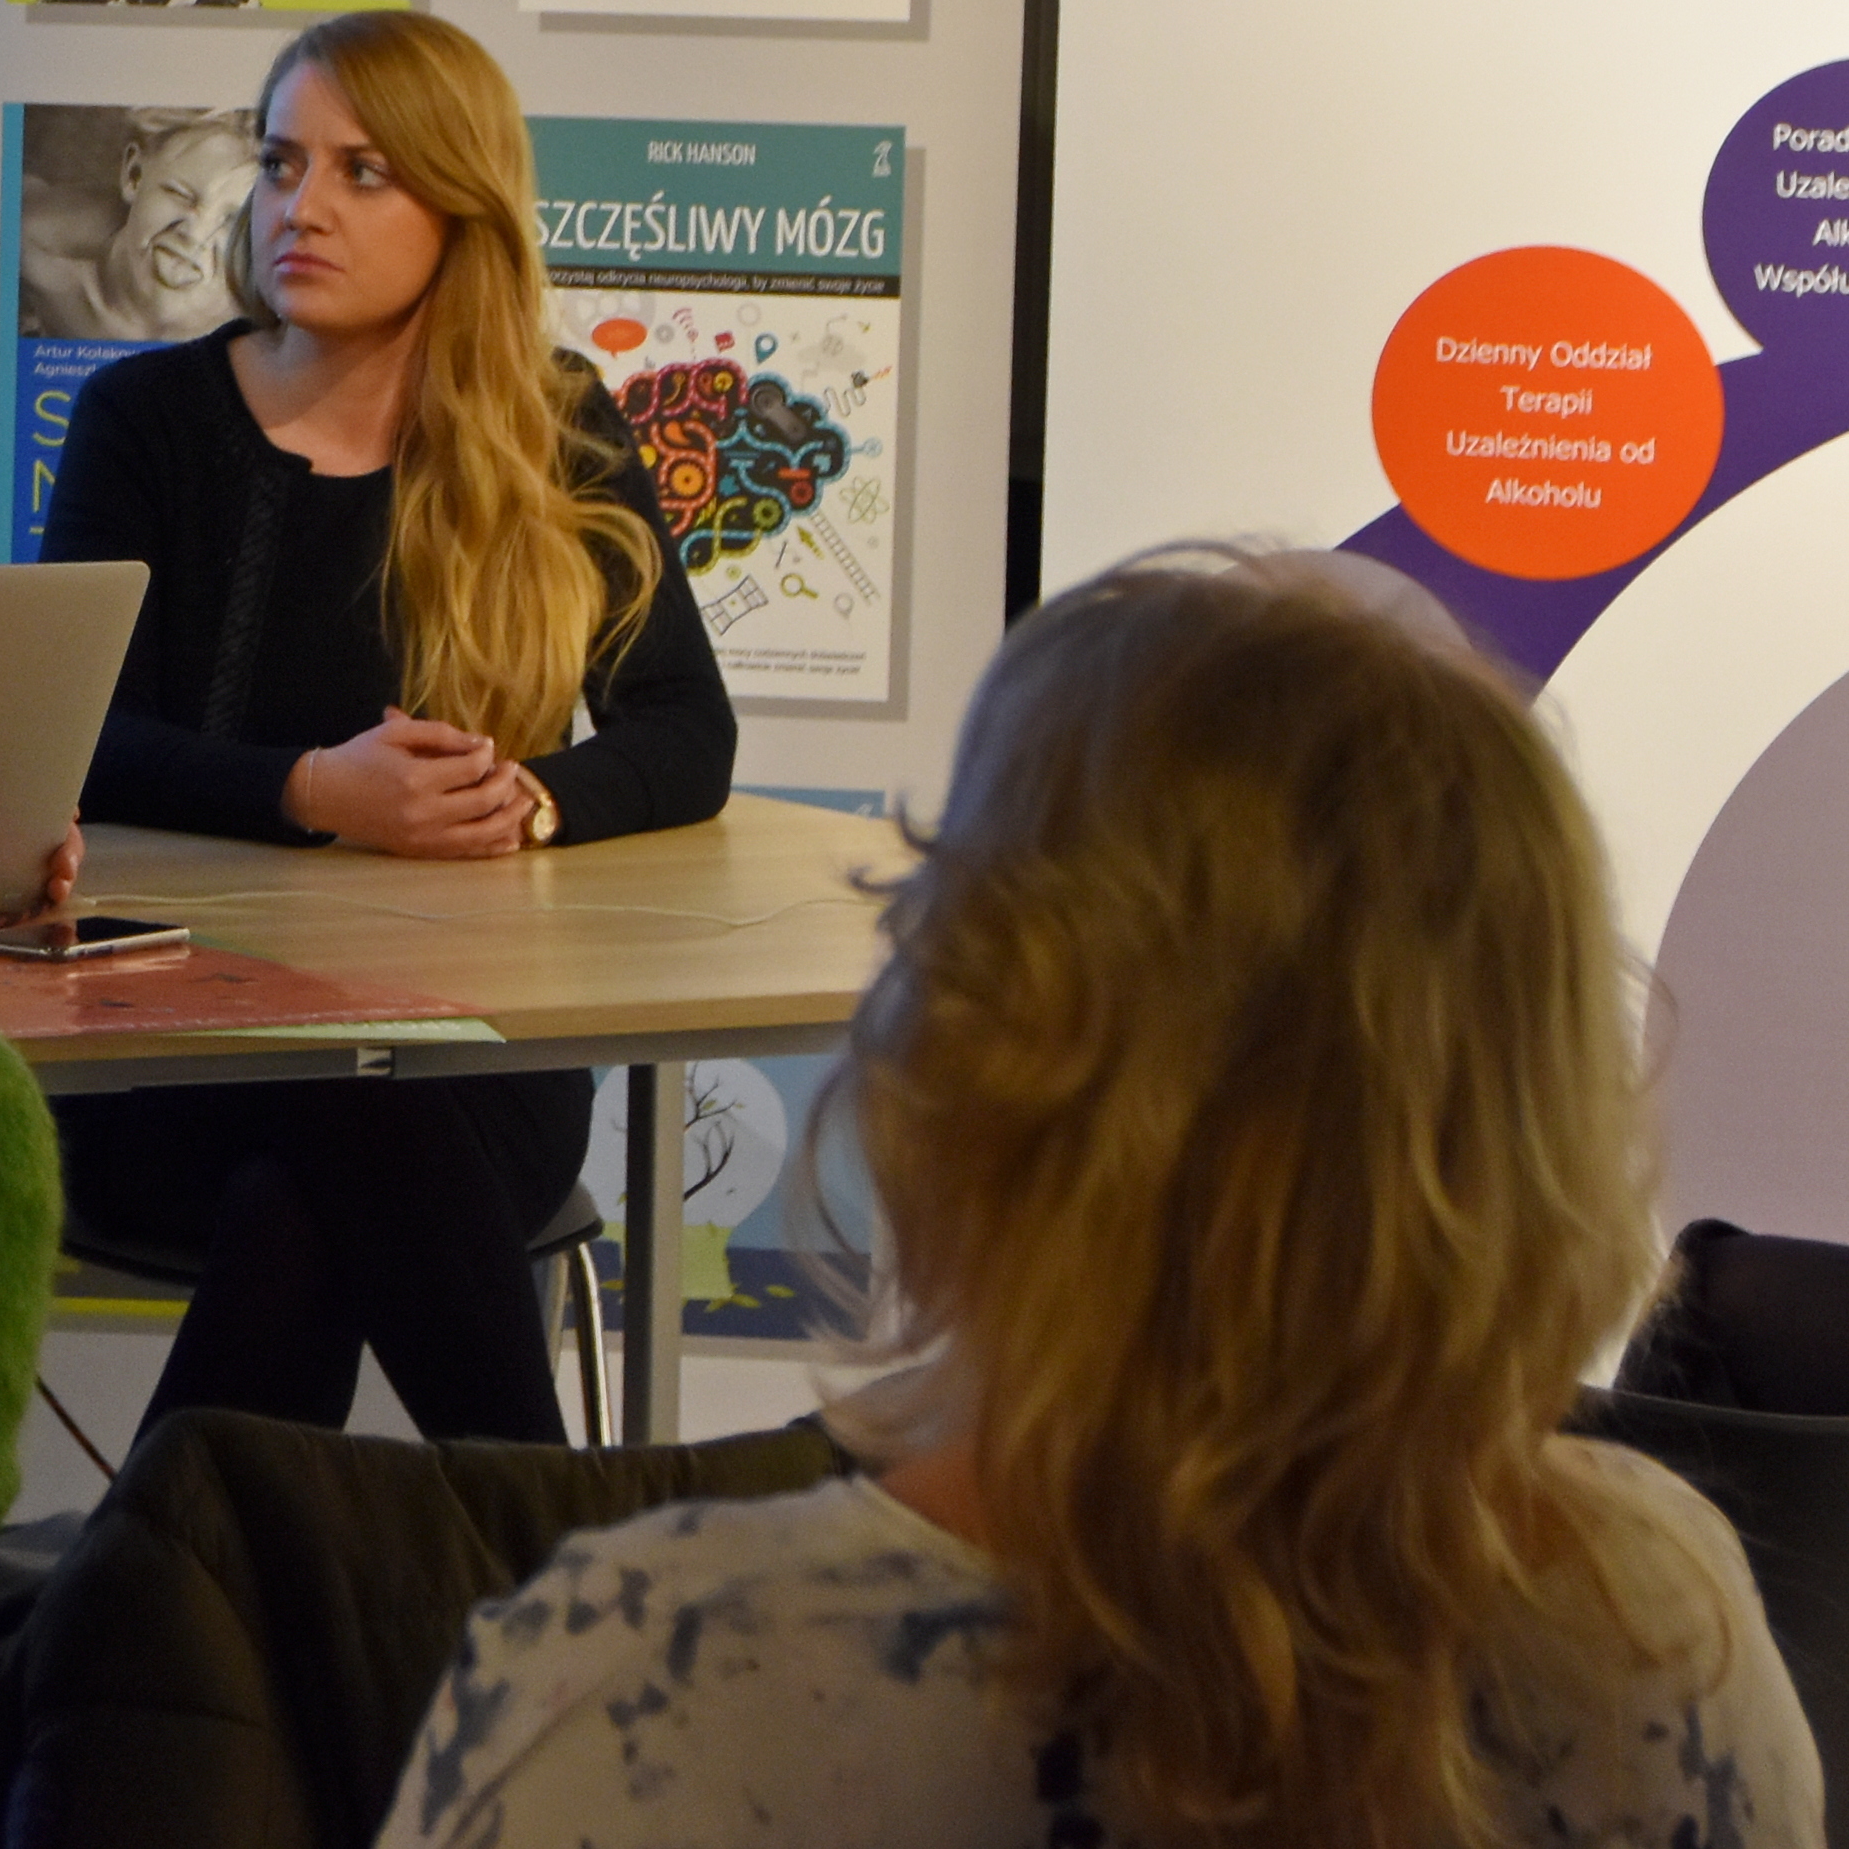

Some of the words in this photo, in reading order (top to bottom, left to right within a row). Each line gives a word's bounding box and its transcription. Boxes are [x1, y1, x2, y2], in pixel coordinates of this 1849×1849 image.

[646, 140, 684, 164] RICK
[686, 141, 757, 166] HANSON
[535, 189, 767, 262] SZCZĘŚLIWY
[775, 193, 886, 260] MÓZG
[1435, 336, 1543, 371] Dzienny
[1548, 340, 1653, 371] Oddział
[1499, 385, 1595, 420] Terapii
[1445, 429, 1613, 464] Uzależnienia
[1619, 437, 1657, 465] od
[1485, 479, 1604, 510] Alkoholu
